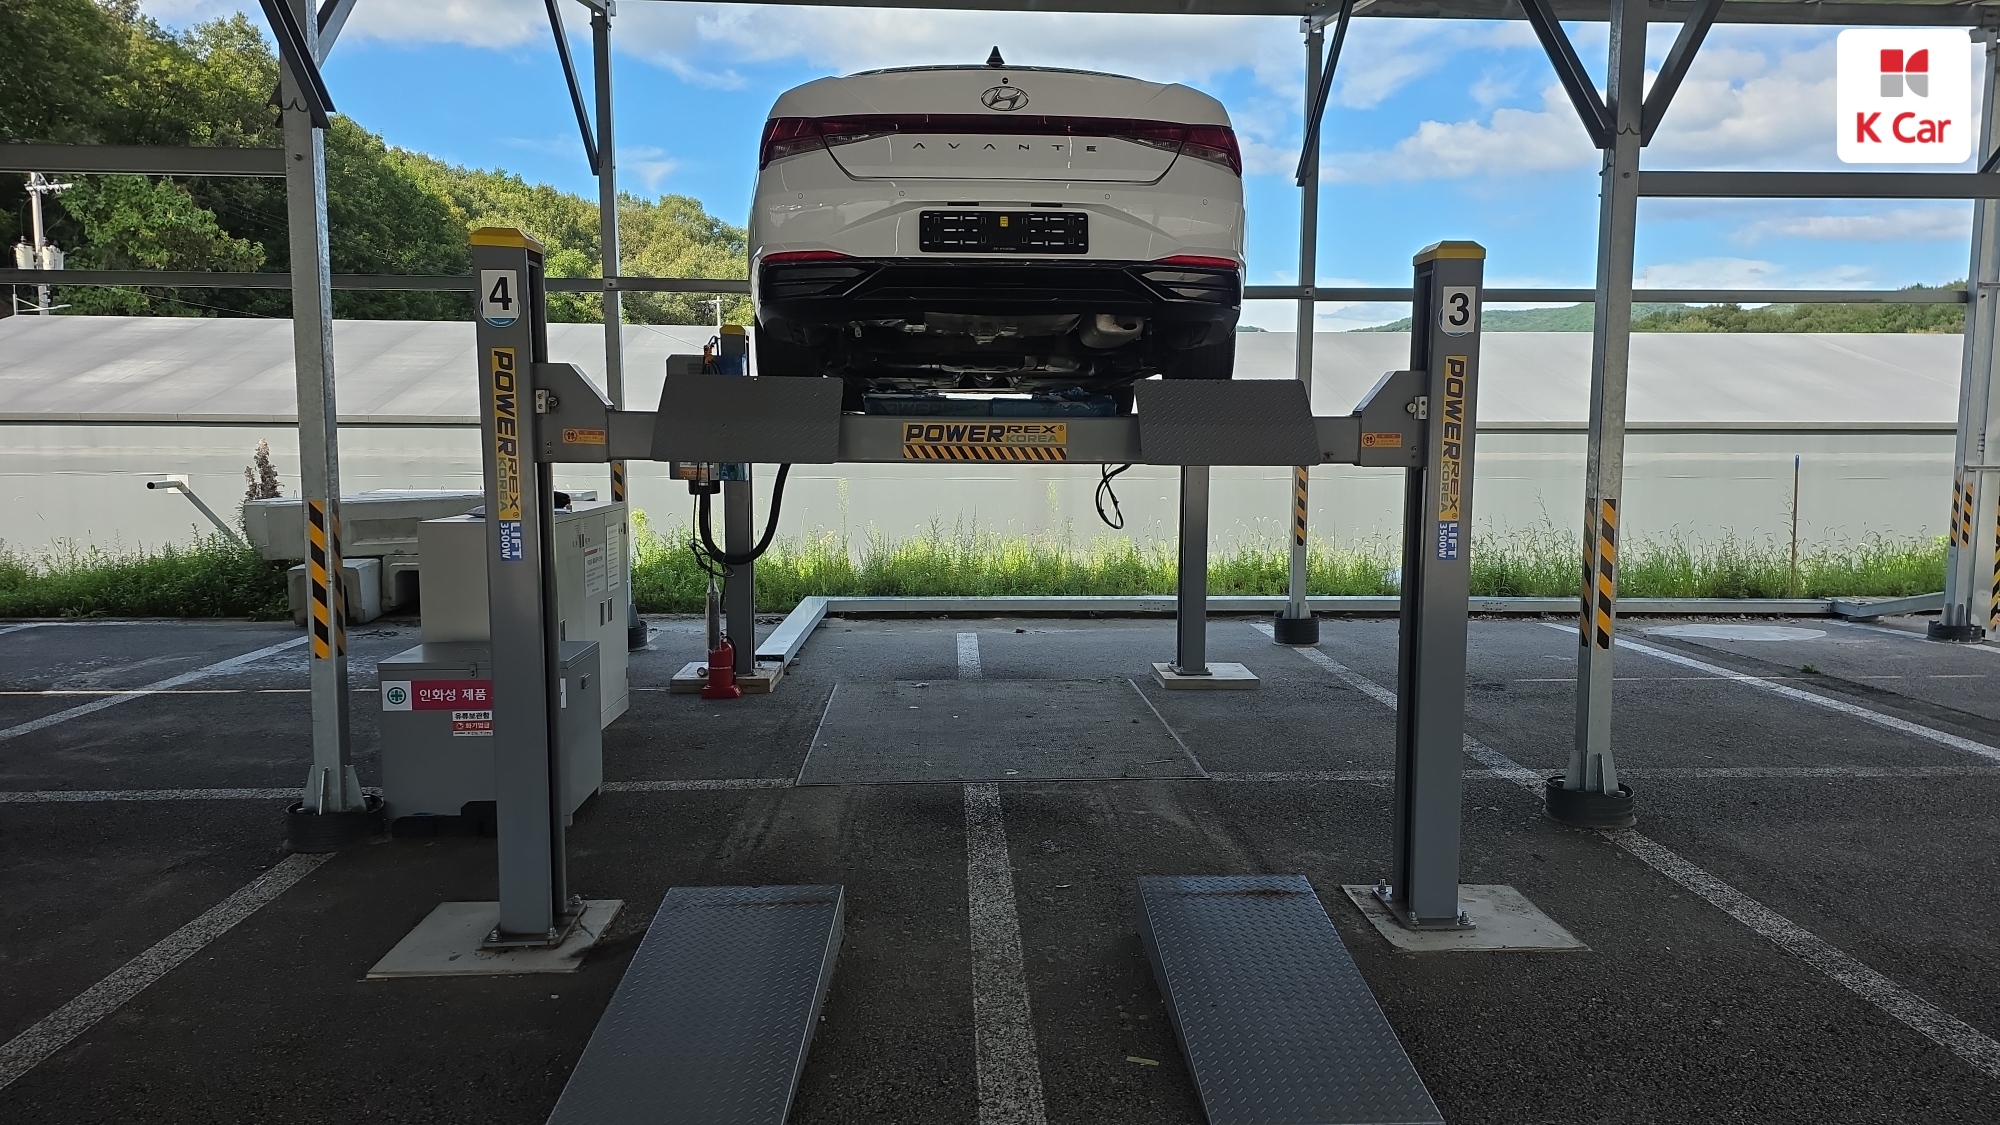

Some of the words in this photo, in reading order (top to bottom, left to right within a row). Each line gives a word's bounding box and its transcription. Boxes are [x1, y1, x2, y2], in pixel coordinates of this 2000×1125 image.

[912, 142, 1097, 153] AVANTE
[489, 276, 512, 311] 4
[1448, 292, 1470, 326] 3
[1006, 434, 1059, 443] KOREA
[498, 457, 509, 512] KOREA
[1440, 460, 1450, 513] KOREA
[500, 522, 511, 560] 3500W
[510, 522, 522, 559] LIFT
[1438, 523, 1448, 559] 3500W
[1447, 522, 1458, 559] LIFT
[419, 688, 457, 702] 인화성
[461, 688, 487, 701] 제품
